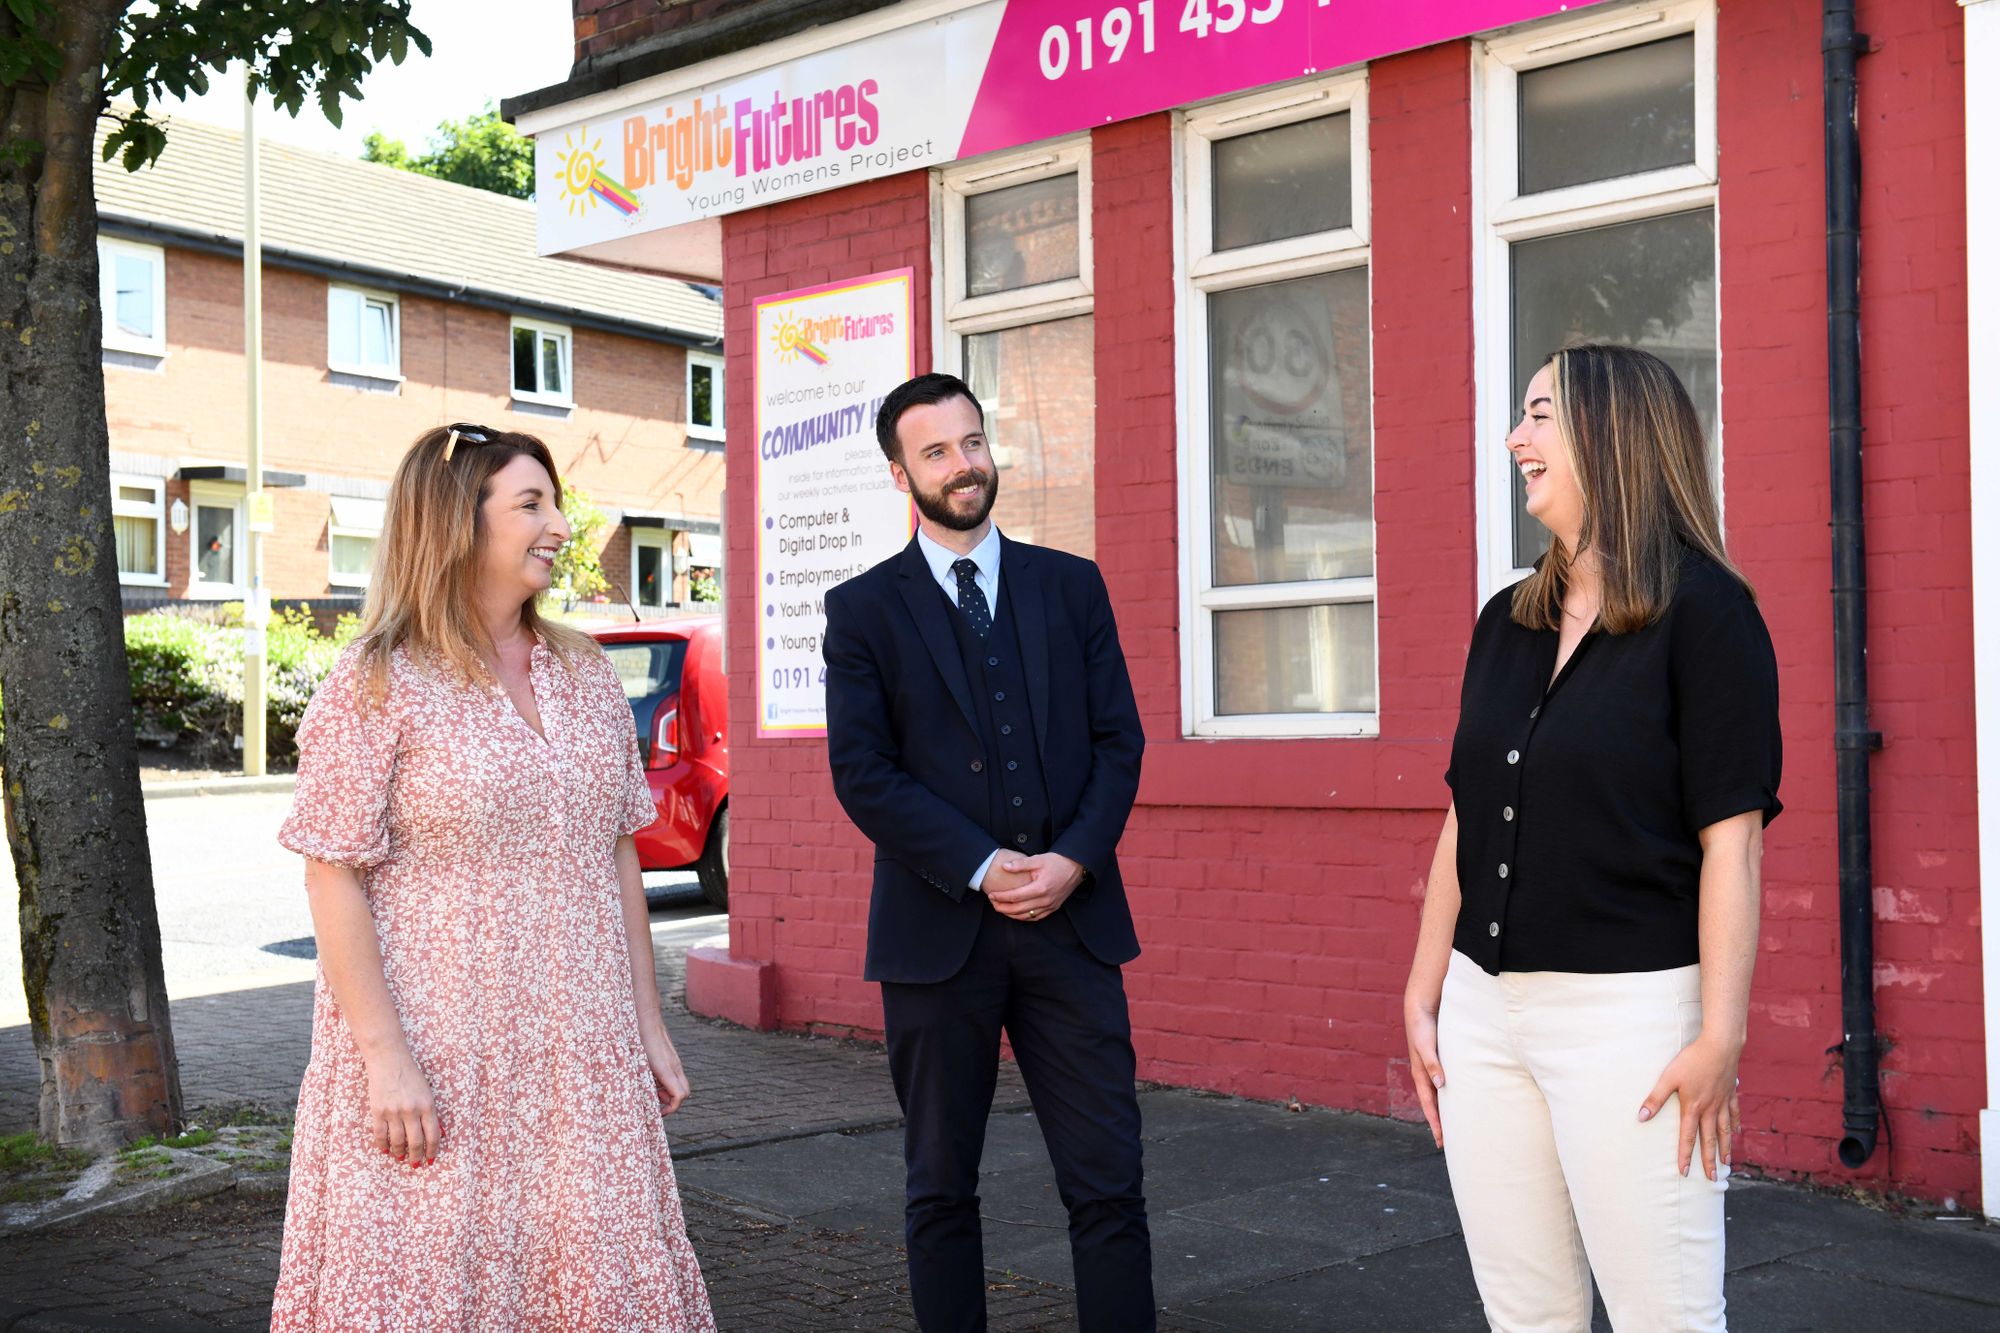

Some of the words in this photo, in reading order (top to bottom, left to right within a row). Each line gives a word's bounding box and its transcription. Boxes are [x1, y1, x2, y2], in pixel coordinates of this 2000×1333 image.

[1039, 0, 1155, 80] 0191
[687, 186, 745, 211] Young
[752, 163, 841, 195] Womens
[850, 139, 933, 172] Project
[767, 386, 824, 406] welcome
[828, 382, 841, 397] to
[844, 379, 865, 395] our
[762, 402, 866, 461] COMMUNITY
[844, 450, 873, 461] please
[812, 470, 824, 480] for
[779, 510, 838, 530] Computer
[841, 507, 850, 523] &
[779, 535, 815, 556] Digital
[819, 534, 848, 552] Drop
[851, 531, 862, 546] In
[780, 564, 852, 587] Employment
[780, 601, 811, 617] Youth
[780, 634, 816, 652] Young
[773, 667, 809, 689] 0191
